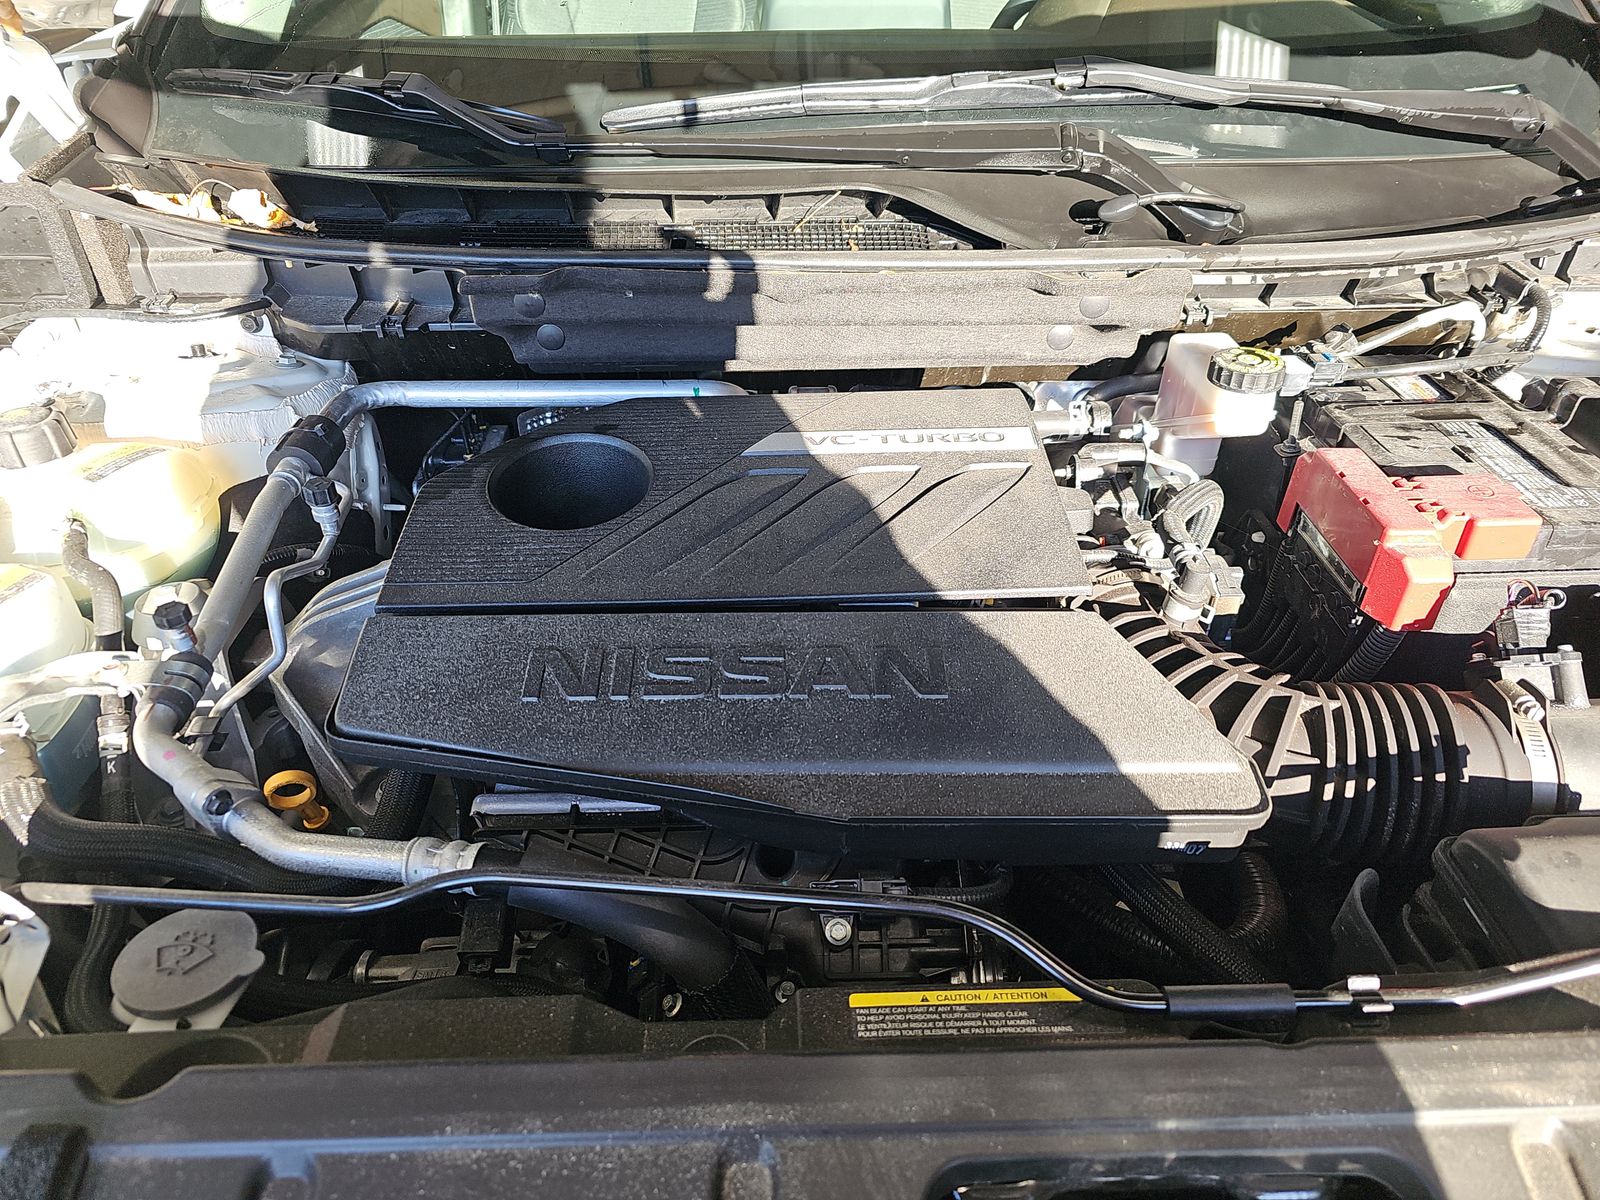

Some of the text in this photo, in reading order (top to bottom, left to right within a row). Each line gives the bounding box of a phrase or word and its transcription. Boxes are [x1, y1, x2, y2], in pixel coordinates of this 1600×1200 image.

[803, 431, 1005, 446] VC-TURBO
[520, 646, 949, 700] NISSAN
[936, 993, 981, 1002] CAUTION
[993, 991, 1049, 1000] ATTENTION
[858, 1030, 878, 1038] POUR
[996, 1025, 1037, 1033] APPROCHER
